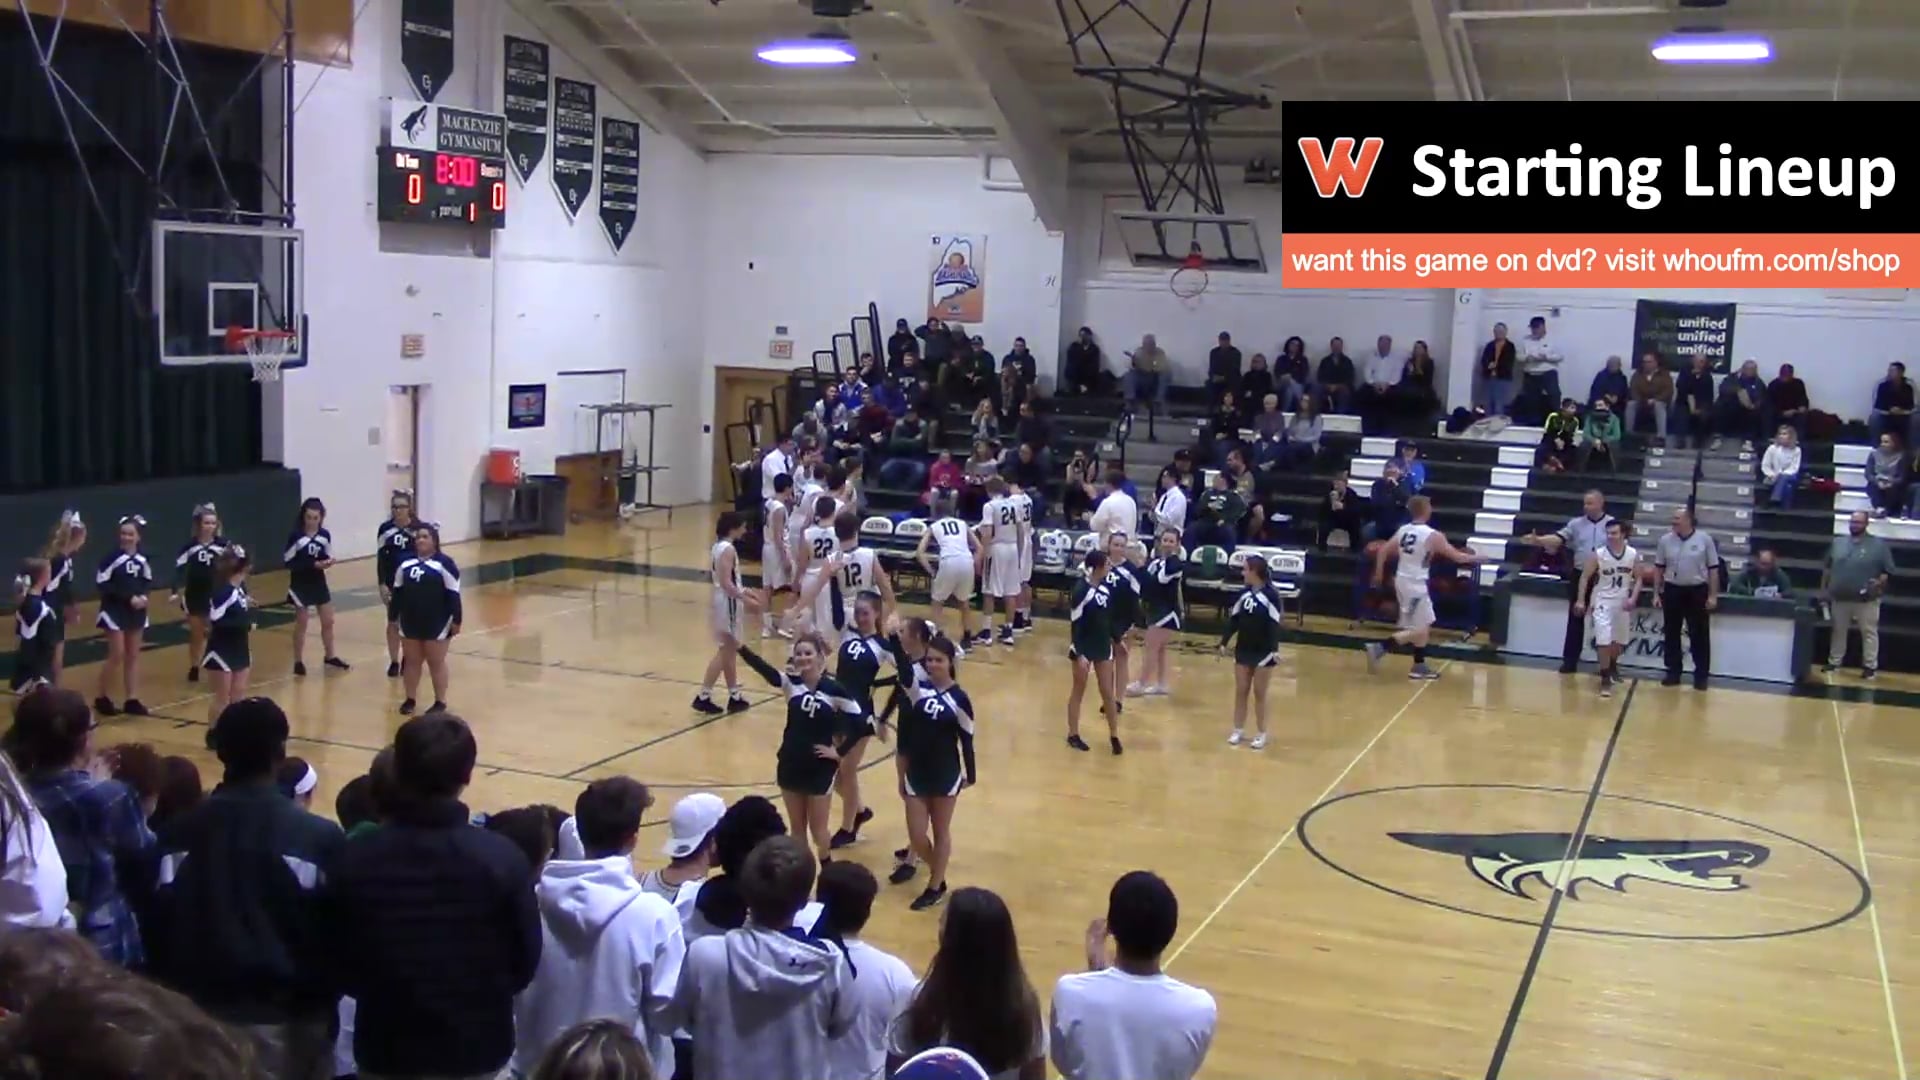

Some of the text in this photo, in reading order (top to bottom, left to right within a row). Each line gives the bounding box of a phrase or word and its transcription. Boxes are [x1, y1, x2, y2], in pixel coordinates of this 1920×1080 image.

[442, 113, 501, 135] MACKENZIE
[440, 132, 501, 153] GYMNASIUM
[436, 155, 475, 187] 8:00
[408, 174, 420, 204] 0
[493, 182, 504, 210] 0
[469, 202, 476, 222] 1
[1001, 506, 1017, 525] 24
[941, 520, 960, 536] 10
[308, 543, 321, 558] OT
[394, 533, 409, 549] OT
[813, 538, 833, 559] 22
[126, 561, 140, 577] OT
[409, 566, 425, 582] OT
[843, 563, 862, 586] 12
[1611, 575, 1623, 588] 14
[847, 640, 865, 660] OT
[801, 694, 820, 718] OT
[923, 698, 944, 720] OT
